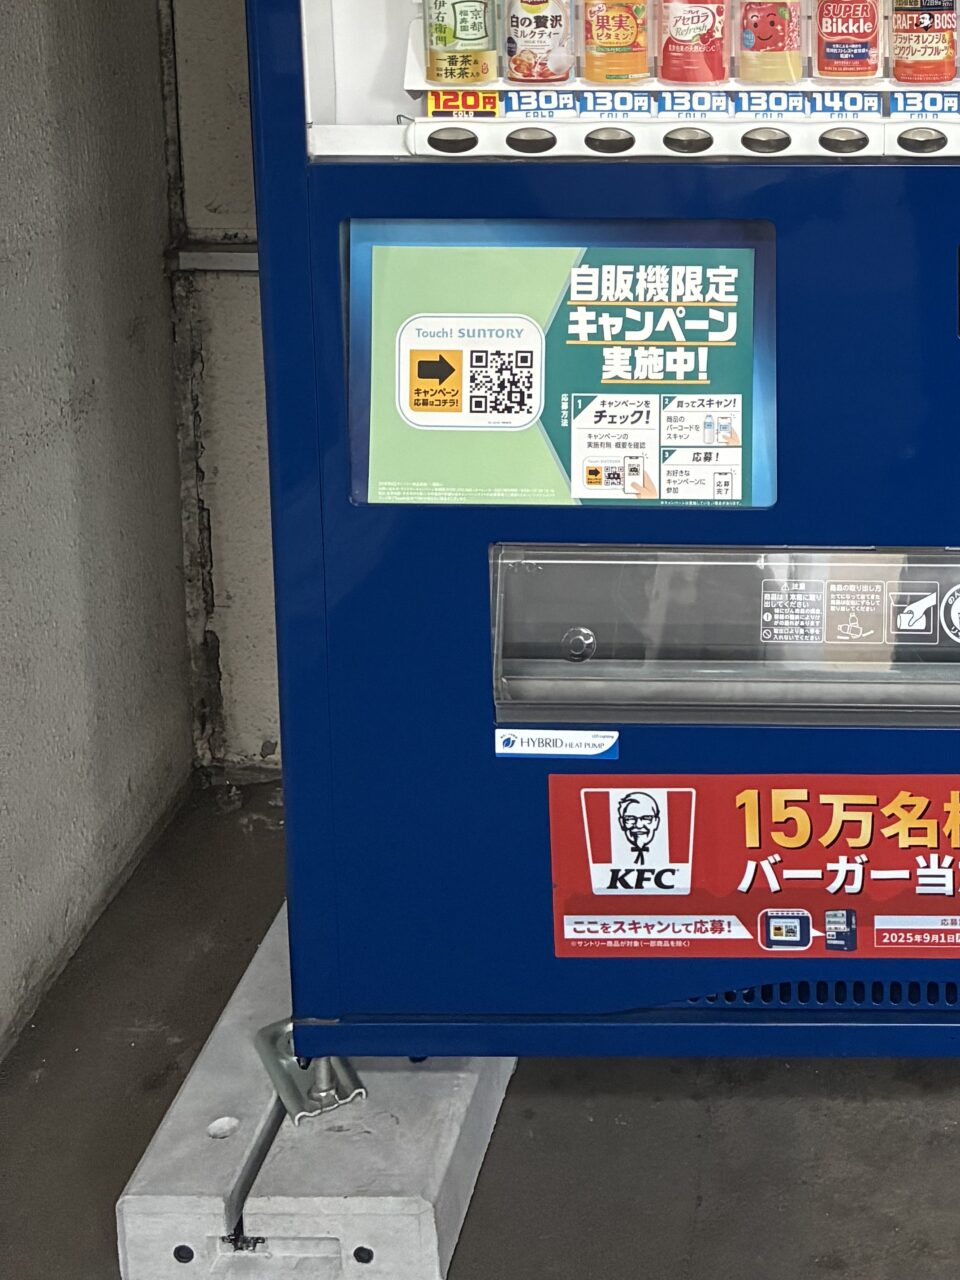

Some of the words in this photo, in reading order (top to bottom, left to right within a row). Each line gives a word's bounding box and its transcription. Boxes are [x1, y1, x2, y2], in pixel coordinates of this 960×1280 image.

[823, 4, 870, 19] SUPER
[510, 14, 563, 30] 白の贅沢
[673, 13, 709, 27] アセロラ
[821, 17, 874, 34] Bikkle
[934, 13, 957, 30] BOSS
[513, 28, 560, 40] ミルクティー
[435, 55, 473, 67] 一番茶
[443, 67, 470, 80] 抹茶
[430, 92, 496, 112] 120円
[508, 91, 574, 111] 130円
[583, 91, 649, 111] 130円
[661, 92, 726, 112] 130円
[738, 92, 803, 112] 130円
[812, 92, 878, 112] 140円
[894, 92, 959, 112] 130円
[569, 264, 739, 303] 自販機限定
[567, 306, 738, 343] キャンペーン
[416, 328, 453, 338] Touch!
[458, 328, 525, 339] SUNTORY
[602, 346, 710, 381] 実施中!
[414, 388, 459, 397] キャンペーン
[413, 398, 459, 407] 応募はコチラ!
[600, 399, 650, 408] キャンペーンを
[676, 398, 736, 408] 買ってスキャン!
[594, 410, 651, 424] チェック!
[692, 451, 719, 463] 応募!
[666, 469, 690, 477] お好きな
[520, 737, 564, 748] HYBRID
[605, 867, 680, 890] KFC
[572, 919, 733, 935] ここをスキャンして応募!
